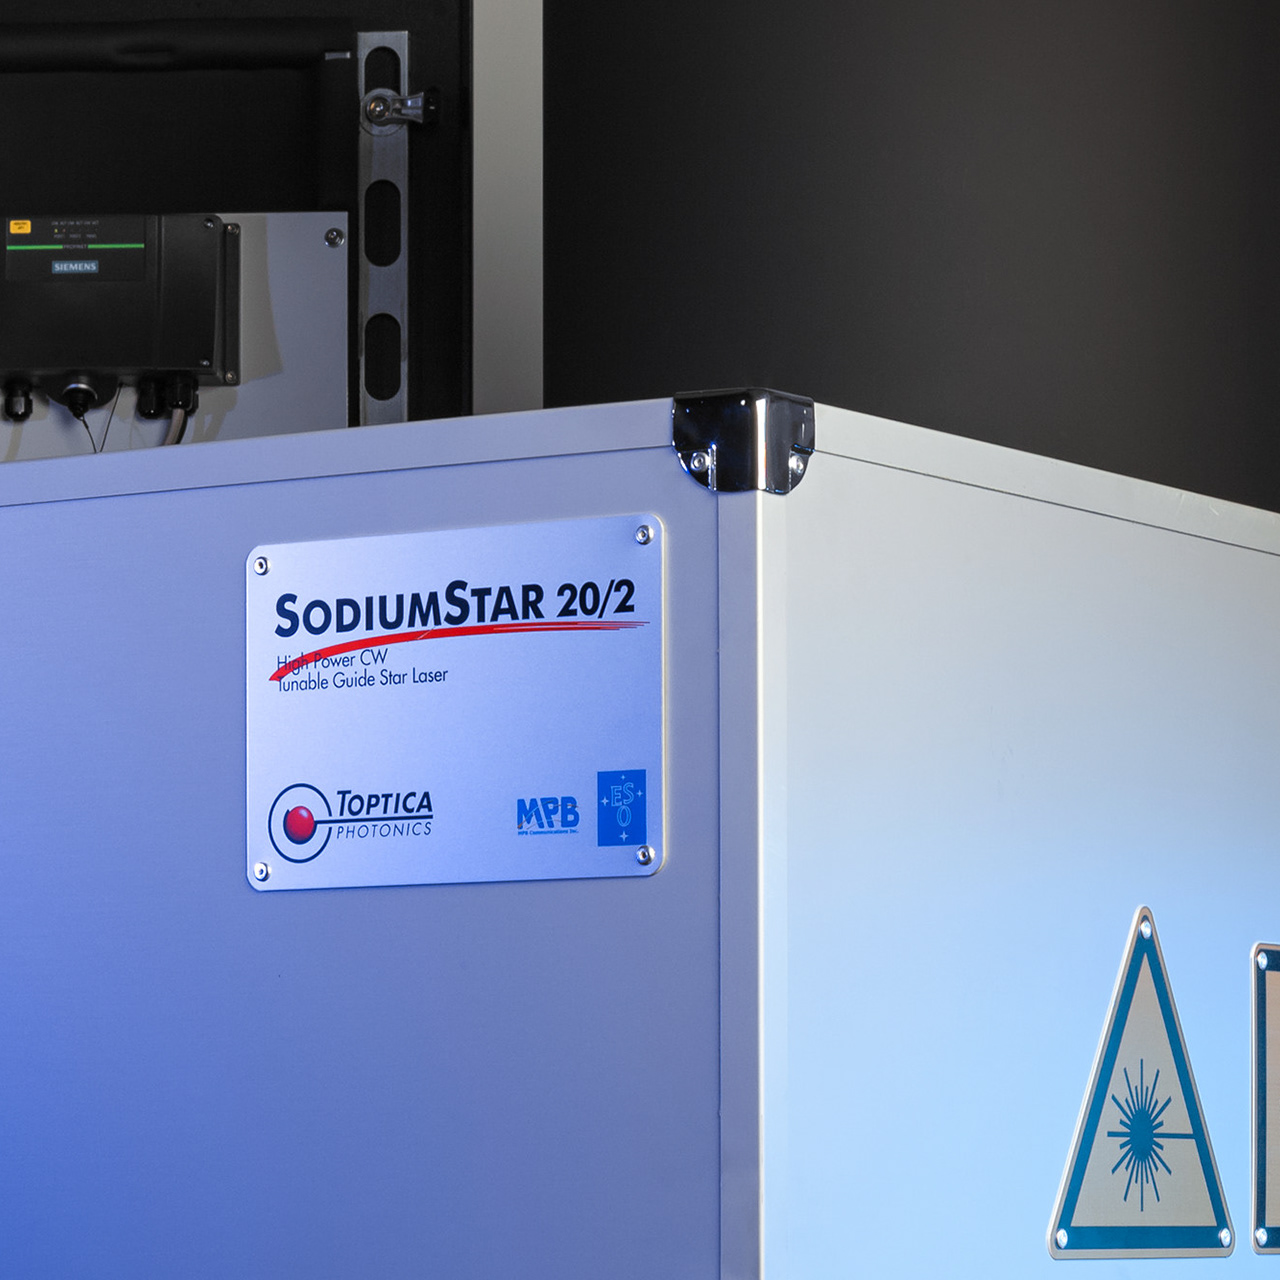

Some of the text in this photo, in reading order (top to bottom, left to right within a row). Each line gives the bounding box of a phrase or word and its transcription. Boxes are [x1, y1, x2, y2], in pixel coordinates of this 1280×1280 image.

[54, 262, 97, 272] SIEMENS
[556, 578, 635, 619] 20/2
[277, 648, 389, 675] High Power CW
[278, 667, 449, 693] Tunable Guide Star Laser
[337, 789, 433, 817] TOPTICA
[517, 796, 580, 830] MPB
[336, 821, 432, 839] PHOTONICS
